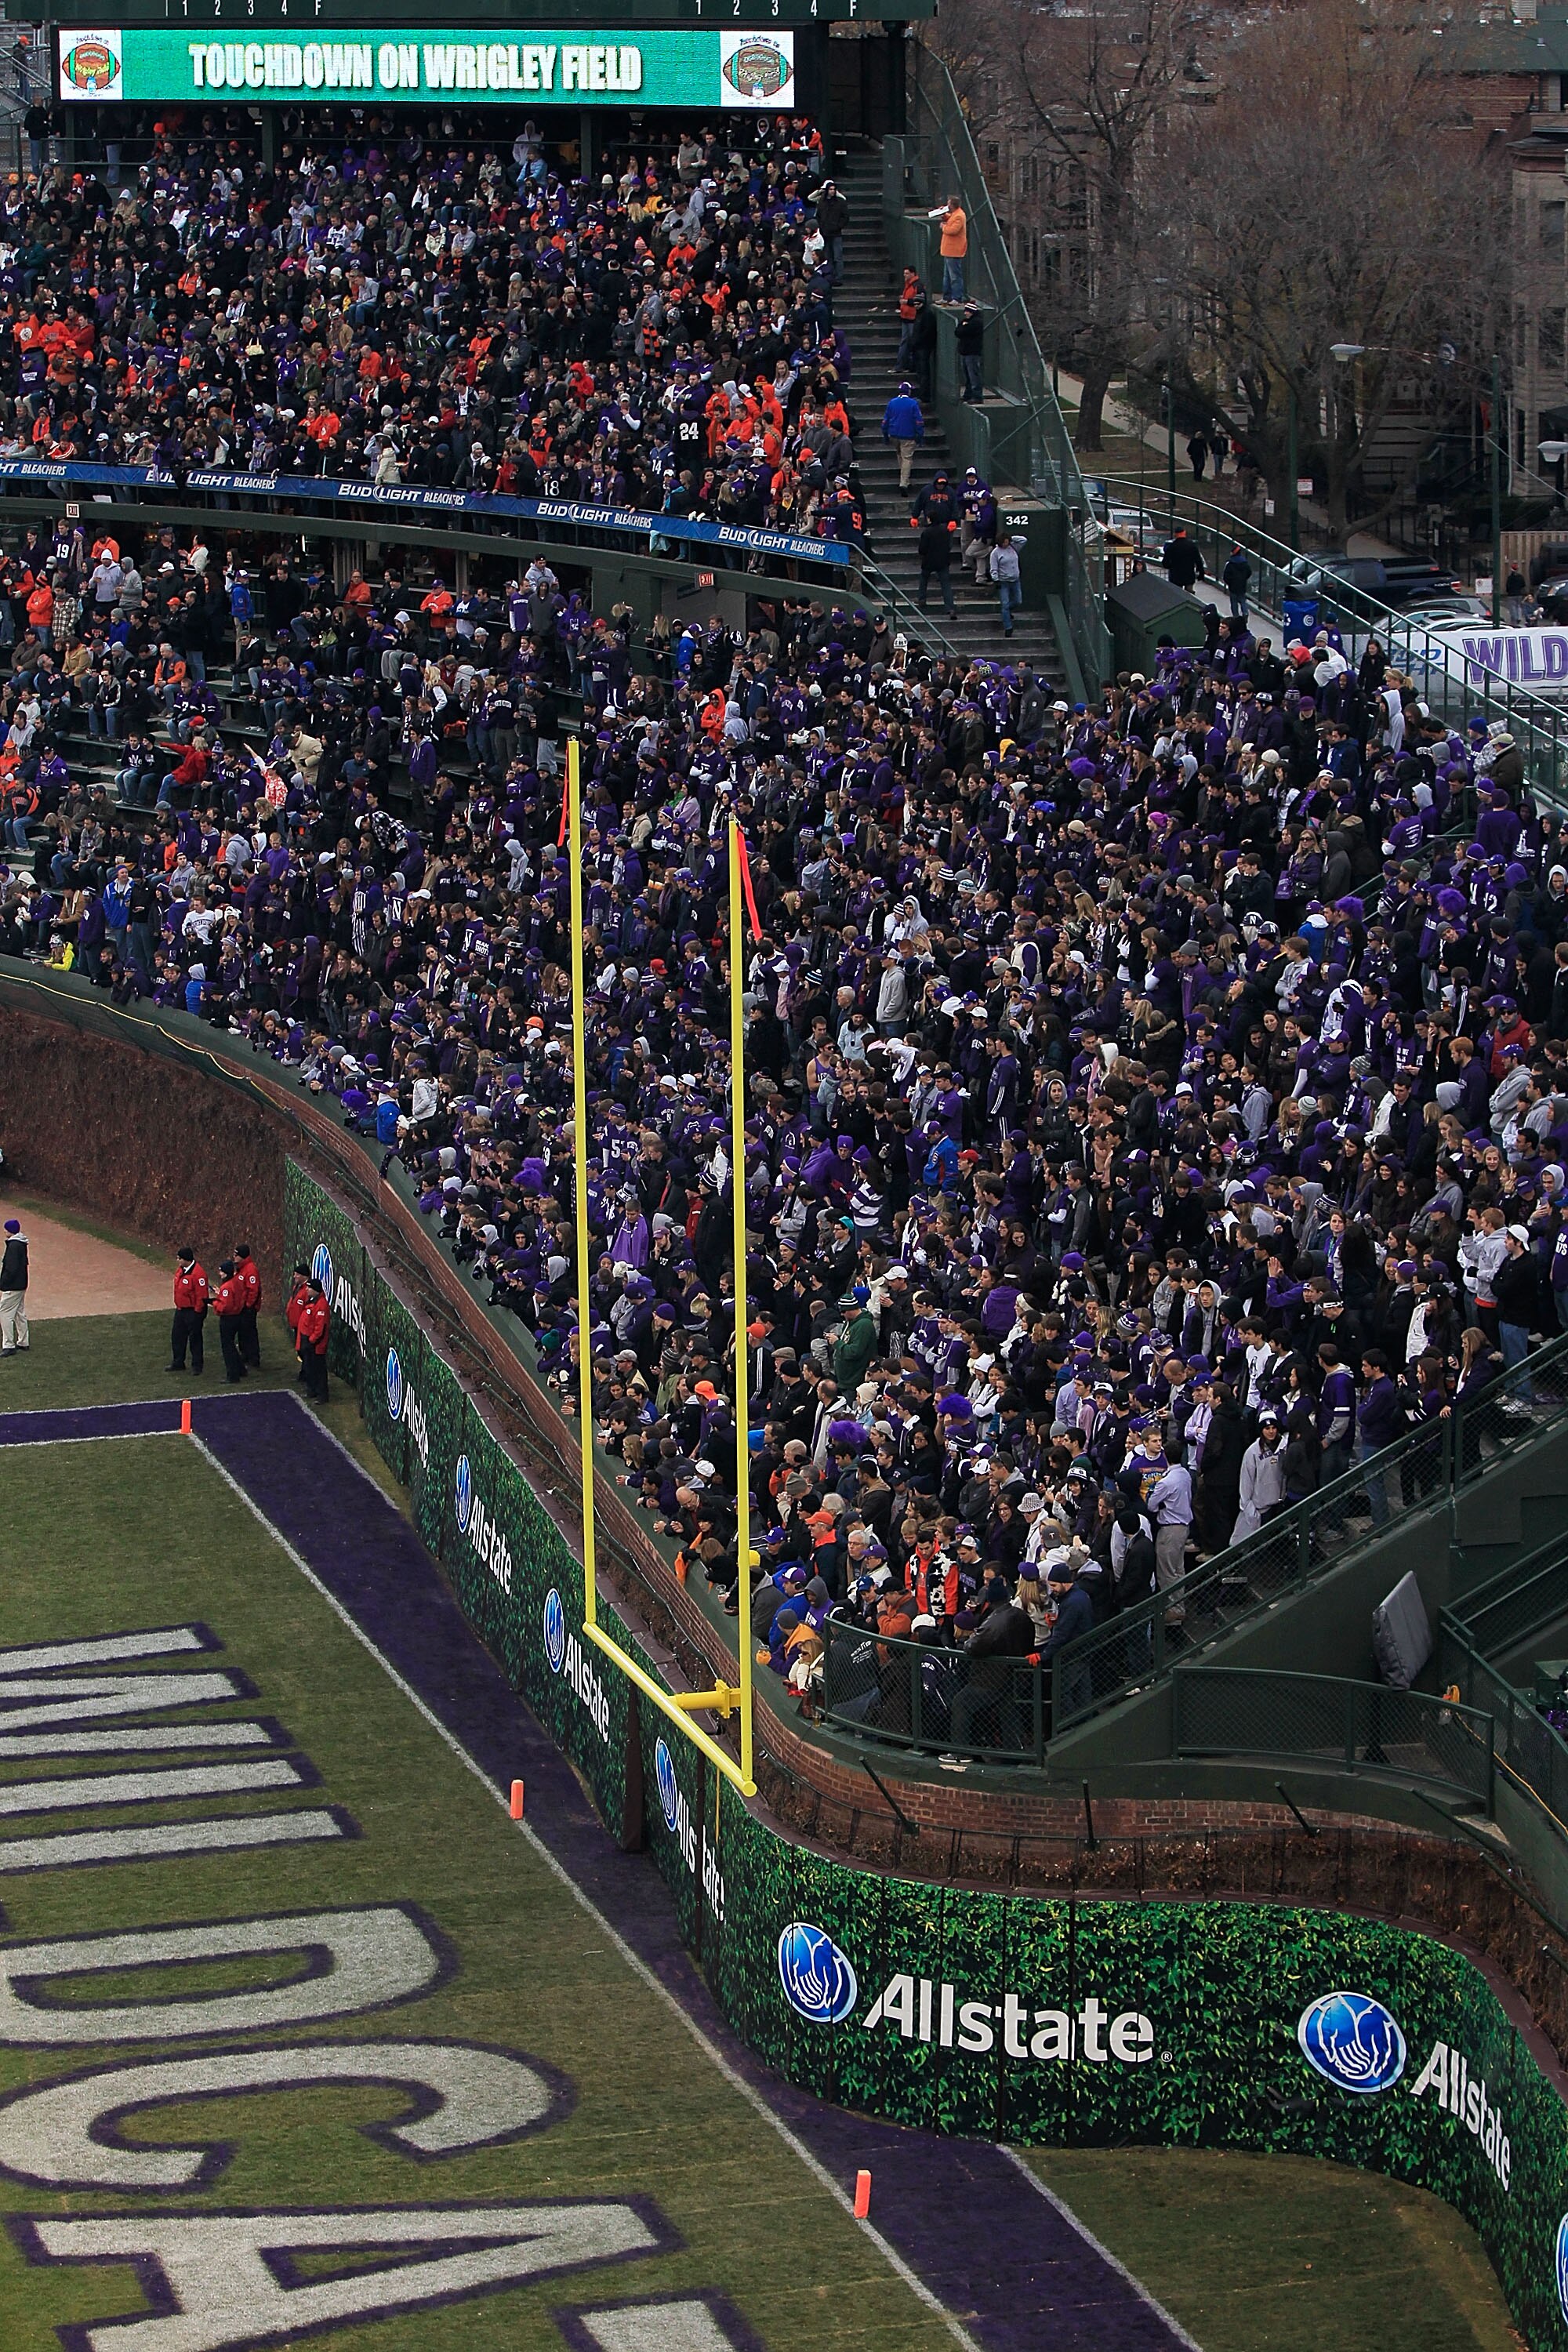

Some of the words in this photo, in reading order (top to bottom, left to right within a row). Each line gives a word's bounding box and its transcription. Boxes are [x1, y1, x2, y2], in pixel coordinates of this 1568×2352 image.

[182, 0, 187, 16] 1
[215, 0, 221, 16] 2
[248, 0, 254, 16] 3
[281, 0, 288, 16] 4
[315, 0, 321, 16] F
[696, 0, 702, 15] 1
[733, 0, 740, 16] 2
[771, 0, 779, 16] 3
[810, 0, 818, 16] 4
[850, 0, 857, 16] F
[188, 42, 372, 89] TOUCHDOWN
[378, 42, 419, 89] ON
[423, 42, 557, 90] WRIGLEY
[561, 45, 642, 91] FIELD
[680, 422, 699, 440] 24
[21, 463, 67, 477] BLEACHERS
[652, 459, 662, 474] 14
[187, 472, 231, 486] LIGHT
[234, 477, 277, 490] BLEACHERS
[543, 480, 560, 496] 18
[338, 484, 372, 497] BUD
[378, 488, 422, 502] LIGHT
[423, 492, 466, 506] BLEACHERS
[536, 503, 569, 517] BUD
[573, 508, 613, 524] LIGHT
[614, 513, 653, 528] BLEACHERS
[1006, 515, 1029, 525] 342
[718, 526, 749, 542] BUD
[752, 533, 789, 551] LIGHT
[790, 539, 826, 556] BLEACHERS
[56, 544, 70, 559] 19
[699, 575, 713, 586] EXIT
[1462, 635, 1568, 684] WILD
[390, 898, 405, 920] N
[469, 1494, 512, 1595] Allstate
[564, 1632, 610, 1743] Allstate
[862, 1973, 1154, 2063] Allstate
[1410, 2041, 1512, 2192] Allstate
